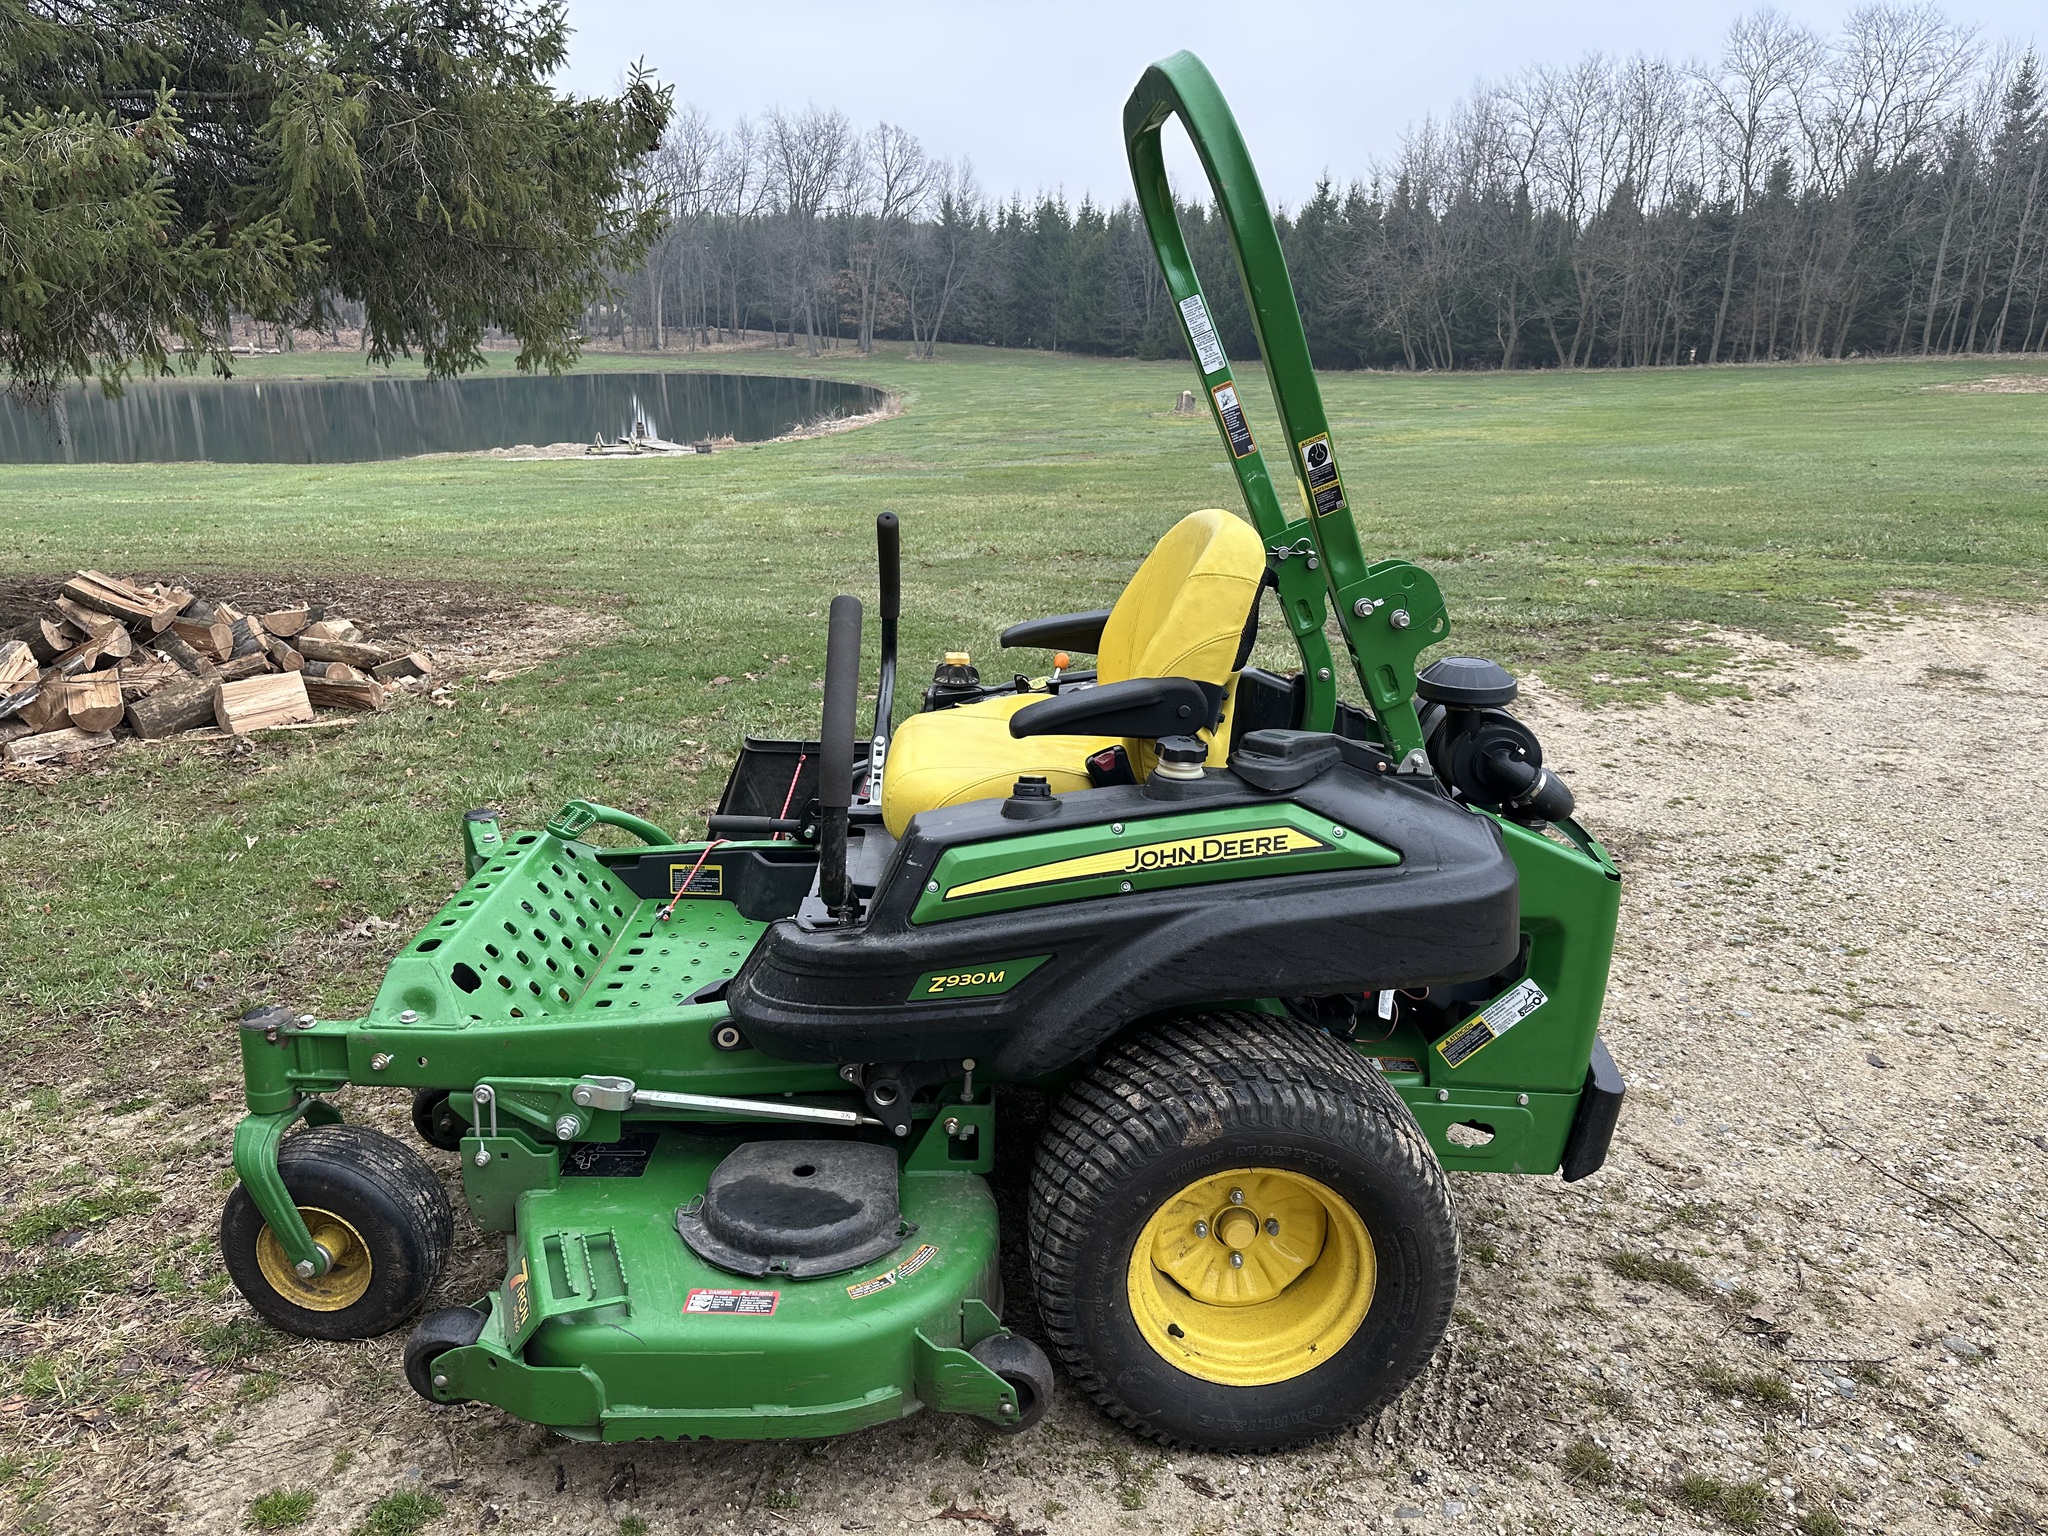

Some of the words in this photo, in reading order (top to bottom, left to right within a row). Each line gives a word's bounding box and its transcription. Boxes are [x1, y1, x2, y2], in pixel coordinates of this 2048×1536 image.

[1125, 845, 1196, 870] JOHN
[1202, 834, 1289, 860] DEERE
[1166, 1150, 1225, 1181] TURF
[1235, 1145, 1339, 1170] MASTER
[1198, 1403, 1323, 1432] CARLISLE
